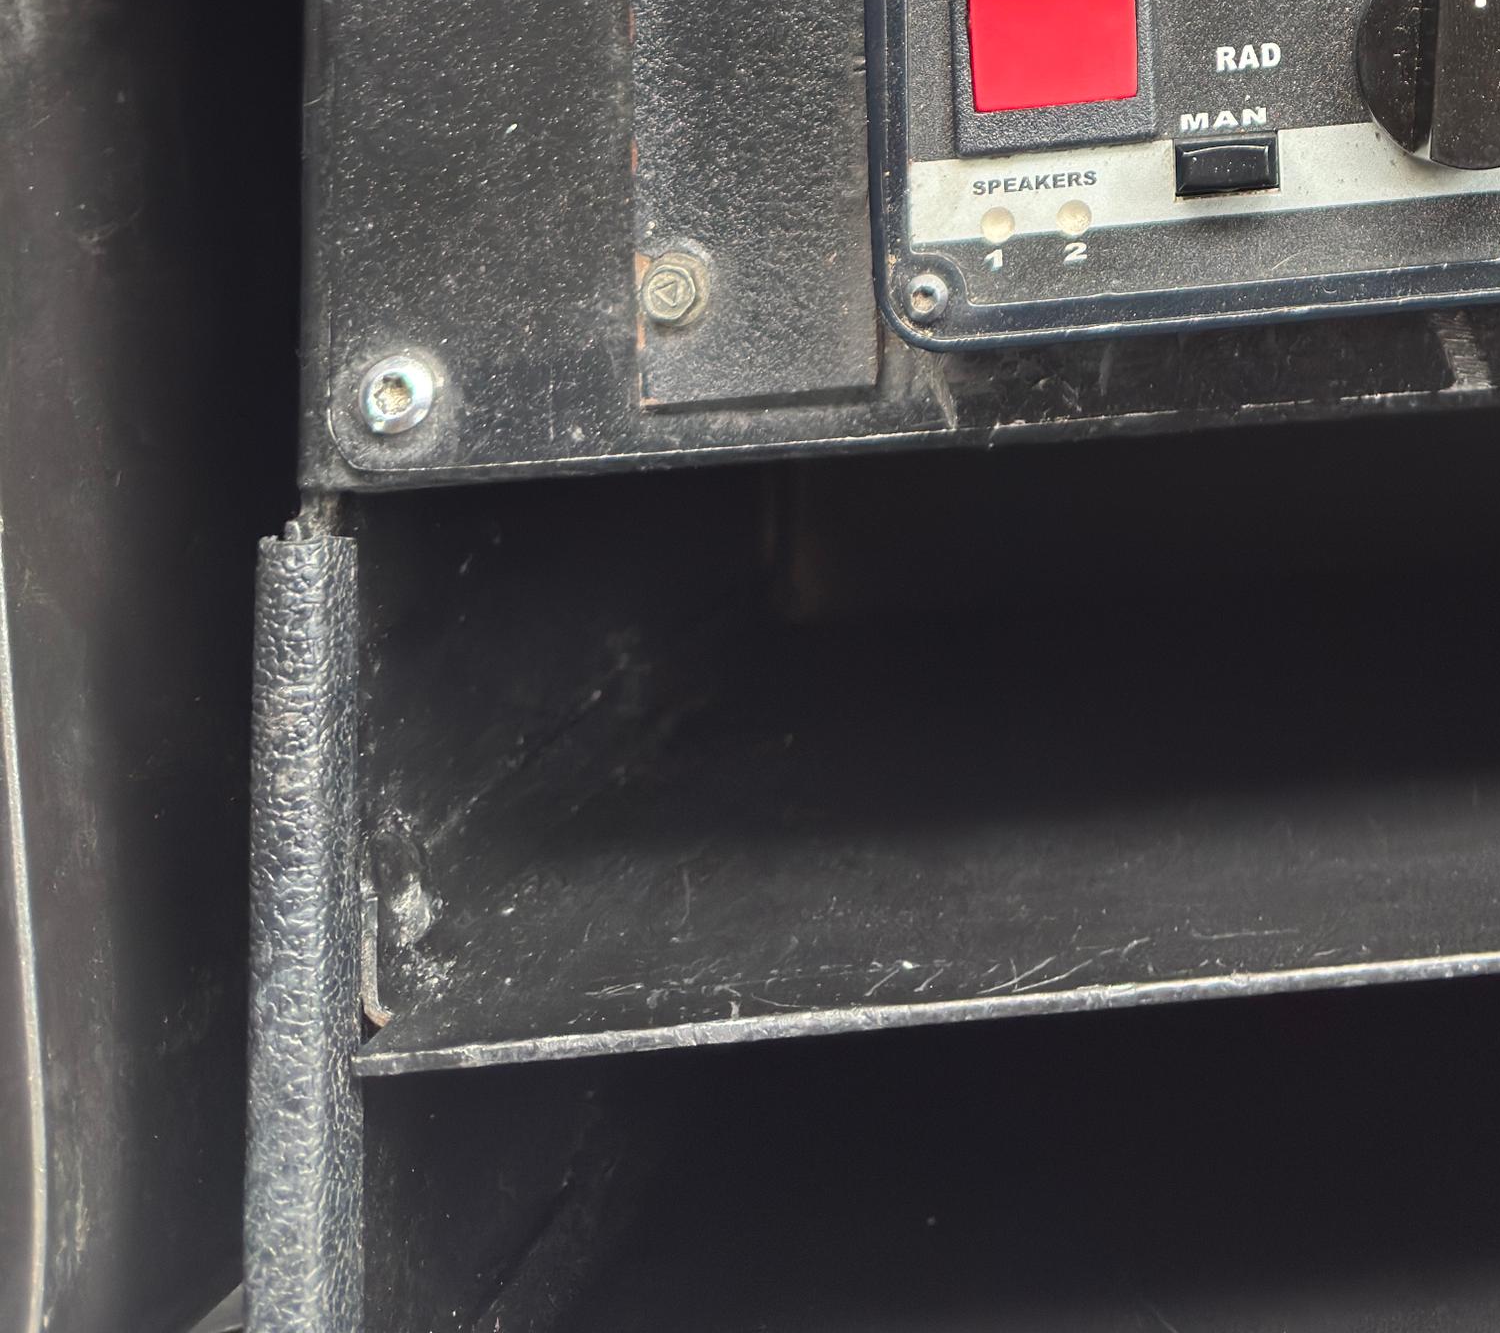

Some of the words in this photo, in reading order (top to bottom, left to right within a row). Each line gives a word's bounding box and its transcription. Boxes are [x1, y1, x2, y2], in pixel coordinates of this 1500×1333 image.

[1215, 42, 1282, 72] RAD
[1180, 107, 1268, 131] MAN
[973, 170, 1098, 196] SPEAKERS
[984, 248, 1004, 271] 1
[1063, 242, 1088, 263] 2
